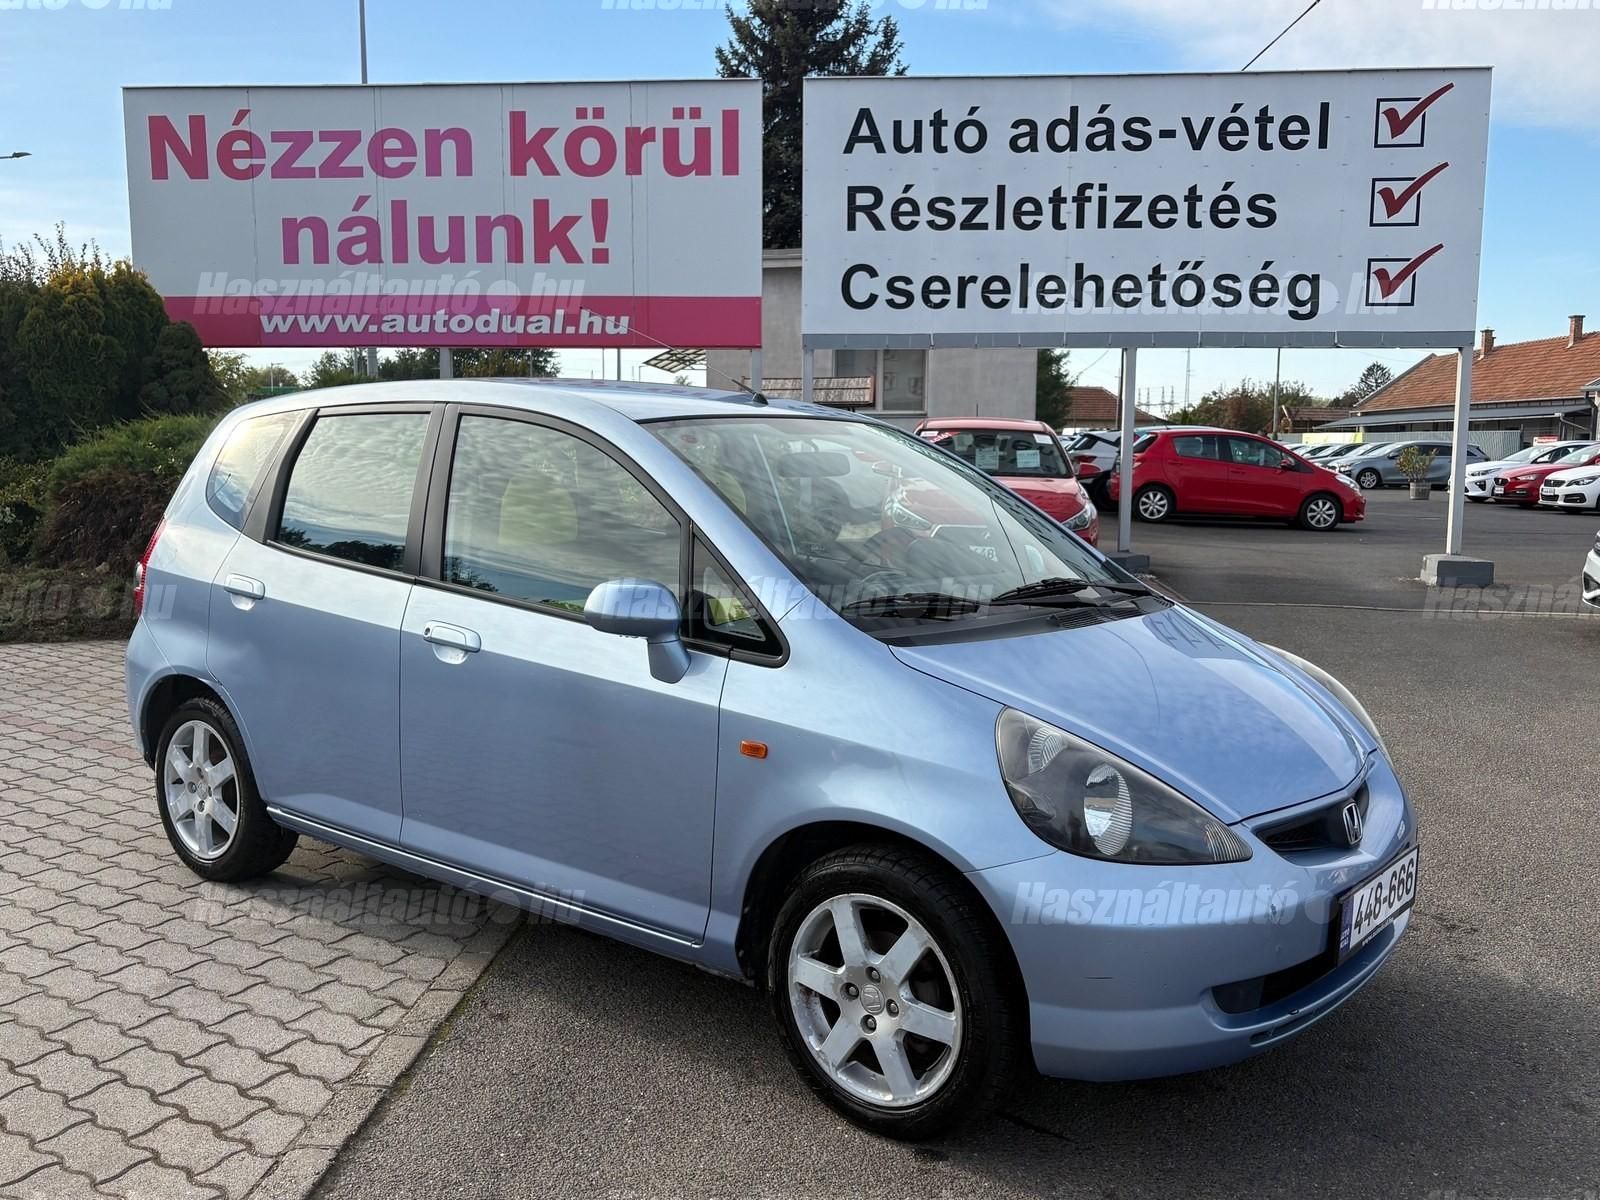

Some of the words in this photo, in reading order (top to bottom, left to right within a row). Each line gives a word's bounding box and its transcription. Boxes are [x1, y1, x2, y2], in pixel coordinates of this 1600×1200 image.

[147, 109, 473, 181] Nézzen
[509, 107, 741, 178] körül
[843, 107, 988, 155] Autó
[1009, 101, 1330, 152] adás-vétel
[282, 196, 610, 265] nálunk!
[846, 181, 1277, 231] Részletfizetés
[840, 259, 1321, 319] Cserelehetőség
[260, 309, 630, 336] www.autodual.hu
[1353, 857, 1415, 935] 448-666
